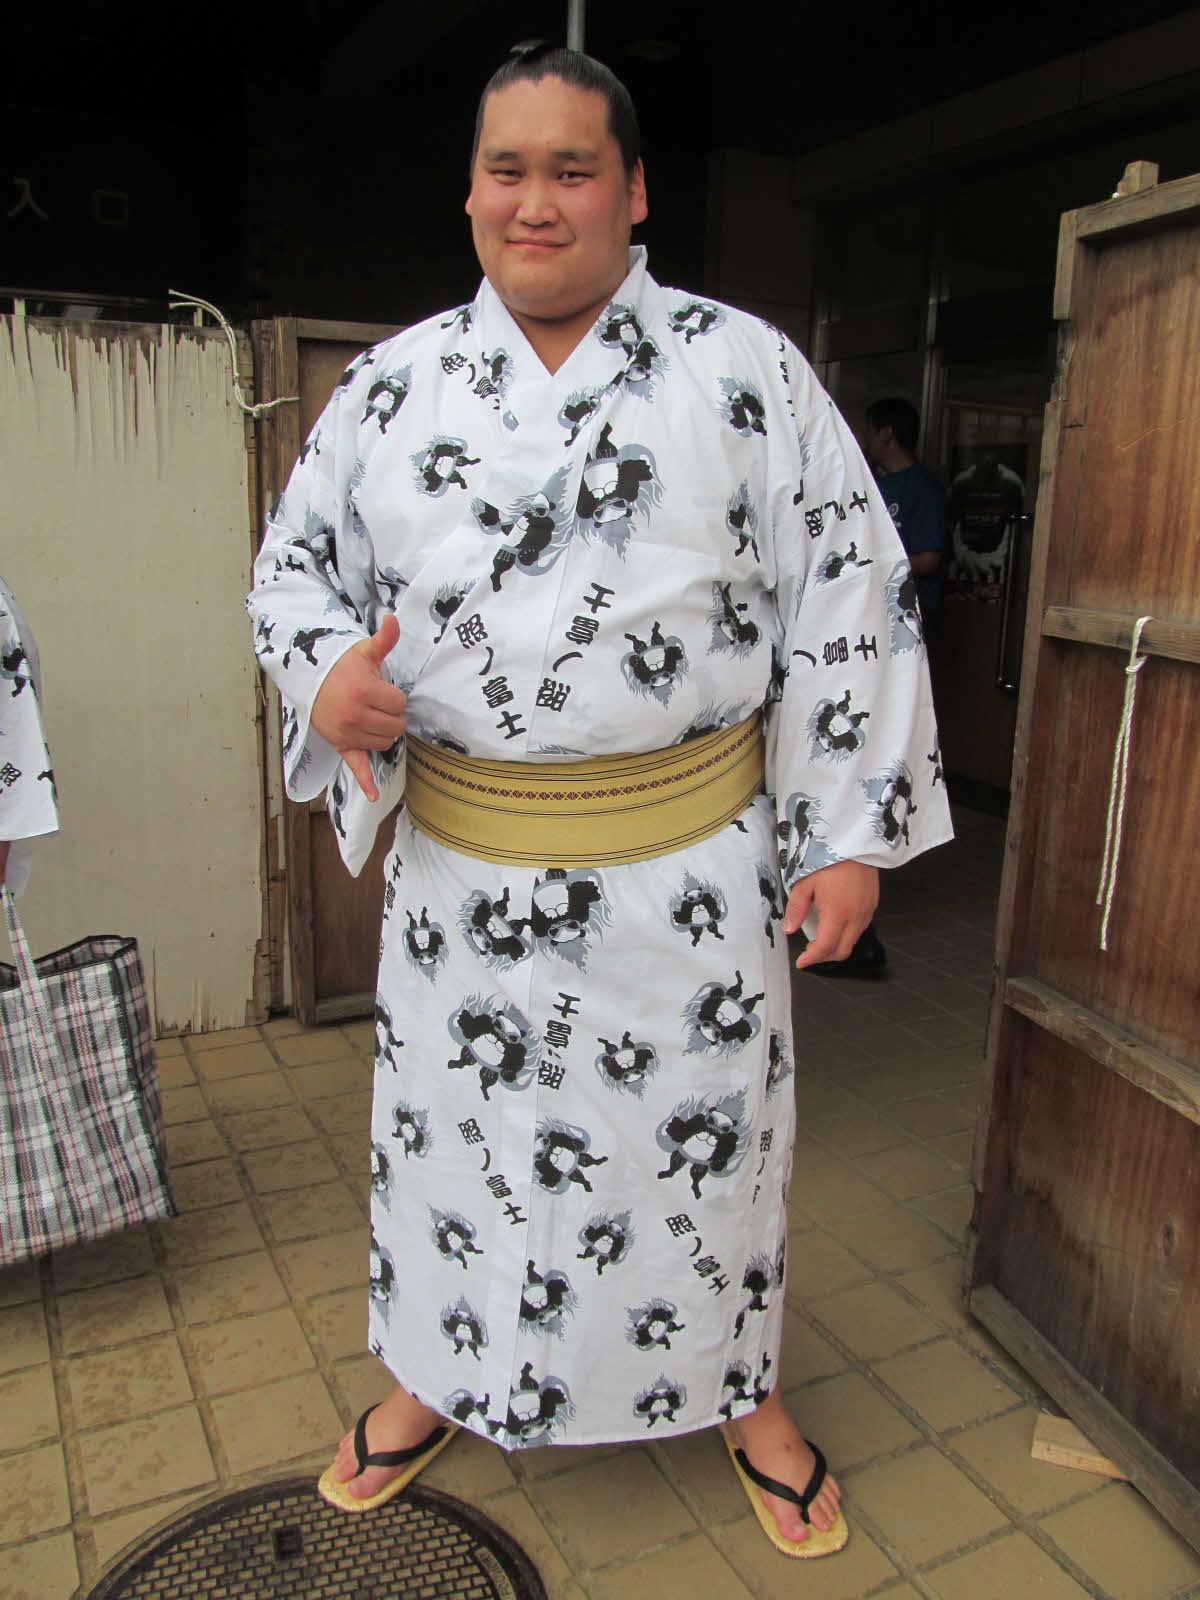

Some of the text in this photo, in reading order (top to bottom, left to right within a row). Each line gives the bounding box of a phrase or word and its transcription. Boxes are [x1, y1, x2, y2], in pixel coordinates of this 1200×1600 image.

[8, 177, 129, 226] 入口
[804, 489, 871, 540] 照ノ士
[454, 612, 528, 740] 照ノ富士
[535, 582, 616, 713] 照ノ富士
[784, 633, 878, 678] ノ富士
[457, 1117, 528, 1226] 照ノ富士
[664, 1212, 731, 1297] 照ノ富士
